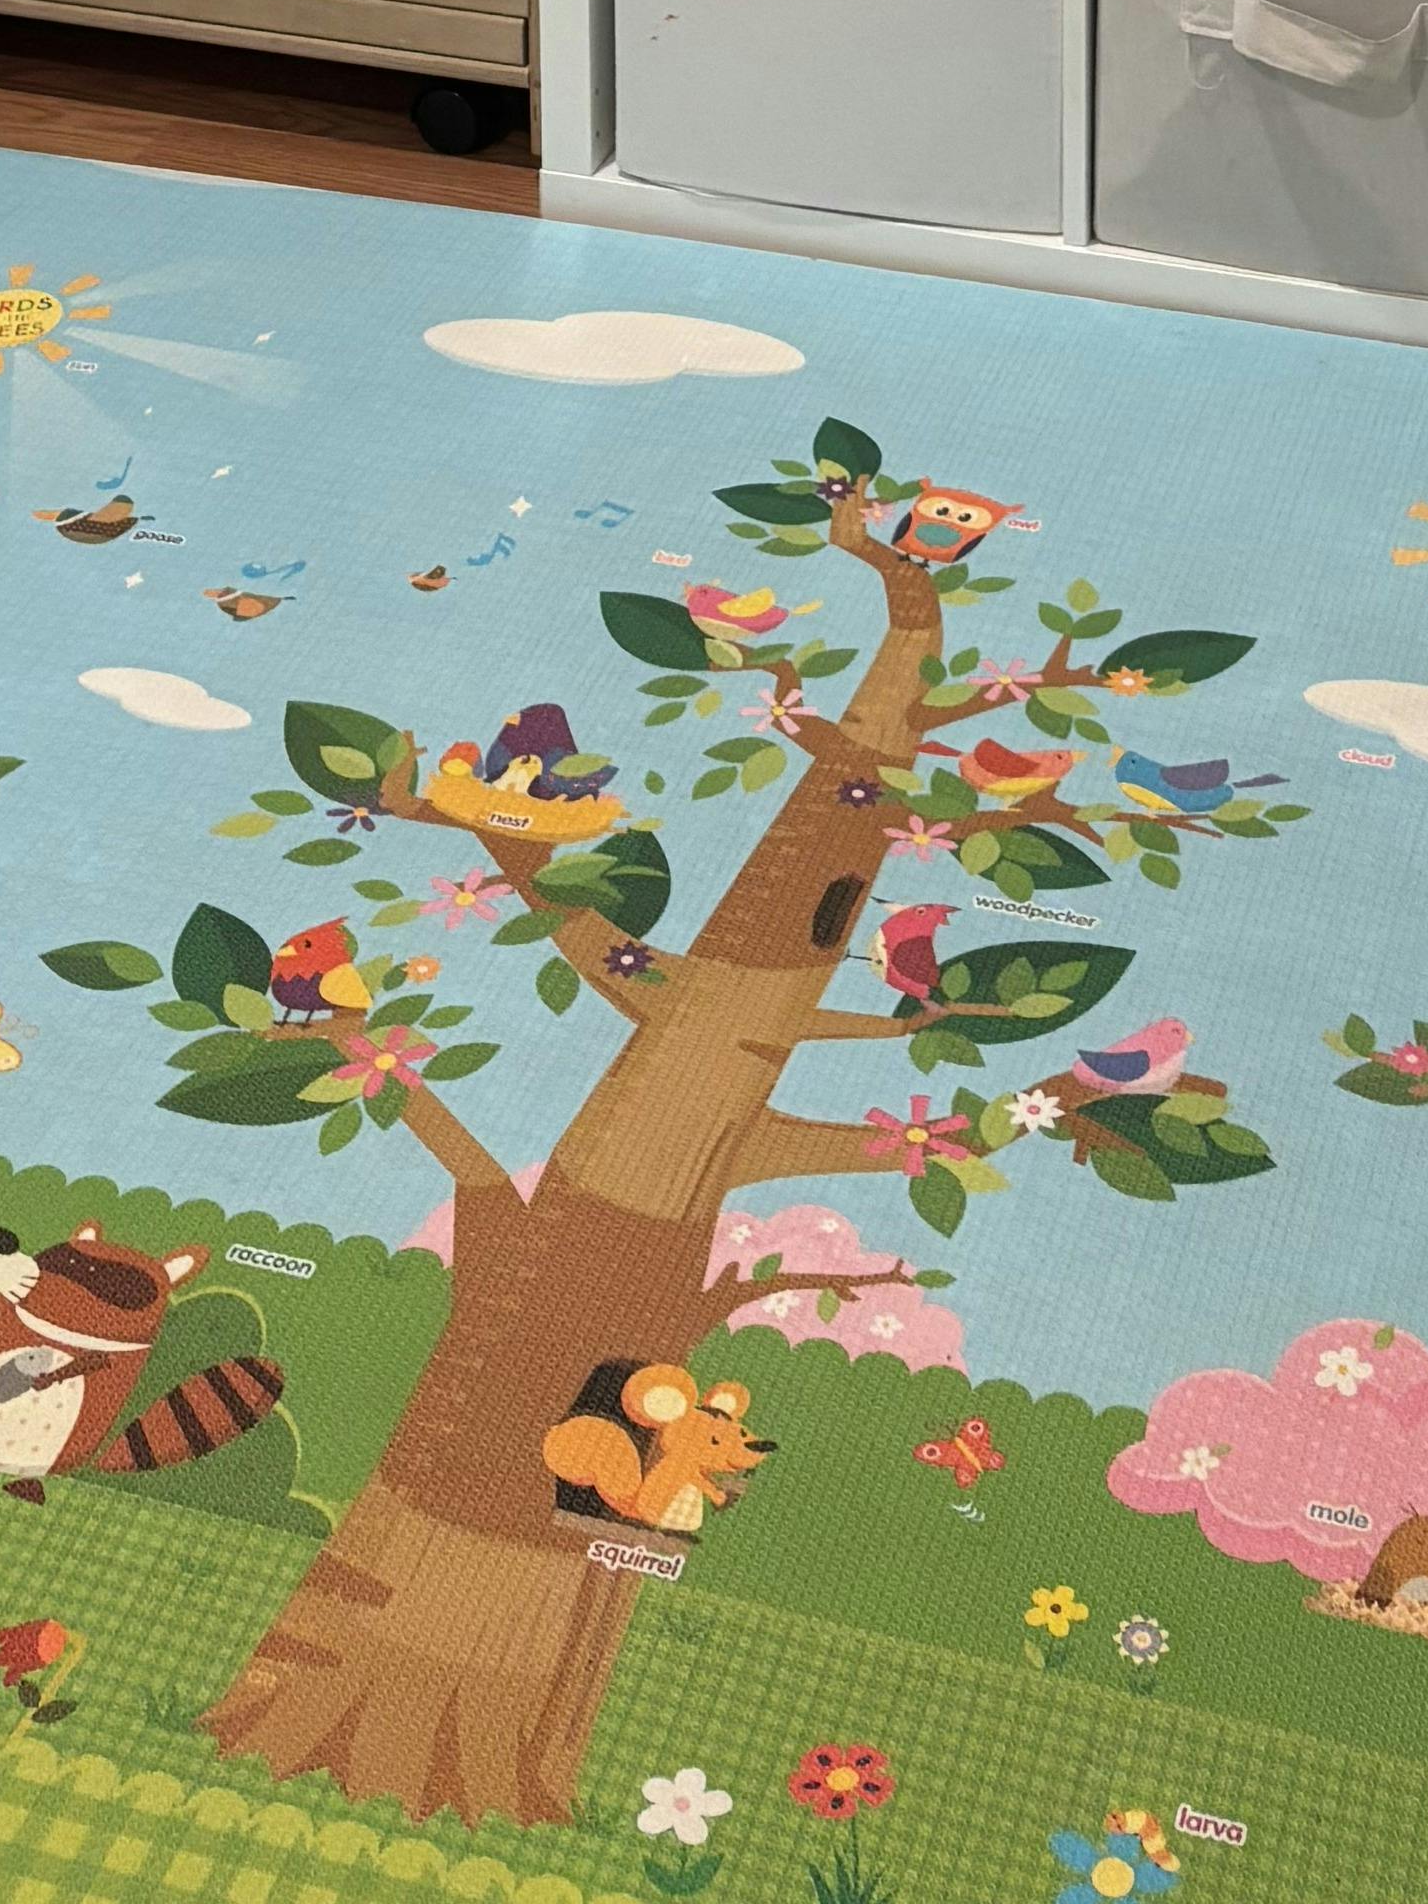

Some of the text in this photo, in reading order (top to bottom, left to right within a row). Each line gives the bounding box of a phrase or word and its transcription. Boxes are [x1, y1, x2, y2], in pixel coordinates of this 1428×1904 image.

[133, 530, 183, 544] goose
[1341, 750, 1393, 767] cloud
[490, 814, 529, 828] nest
[975, 896, 1097, 928] woodpecker
[229, 1246, 312, 1275] raccoon
[1309, 1504, 1369, 1529] mole
[591, 1543, 681, 1577] squirrel
[1178, 1806, 1243, 1842] larva
